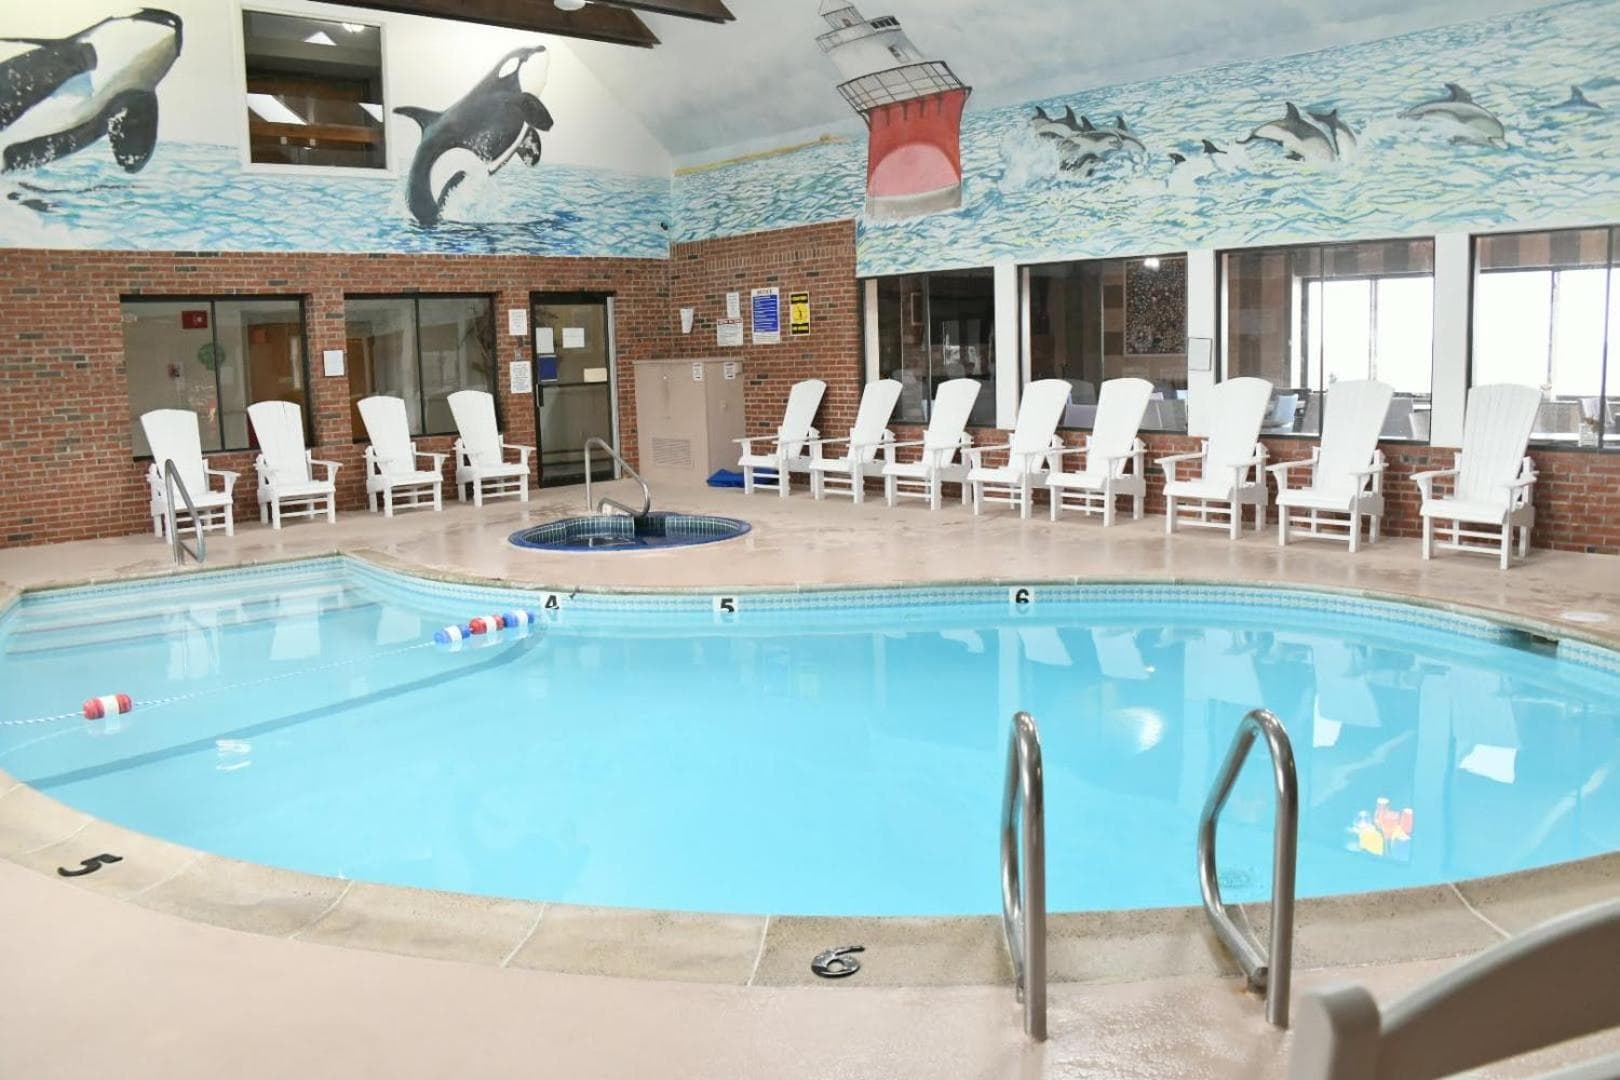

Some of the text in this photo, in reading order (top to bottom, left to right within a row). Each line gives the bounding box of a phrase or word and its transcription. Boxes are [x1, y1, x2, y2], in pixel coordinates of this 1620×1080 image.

[545, 595, 560, 610] 4
[1016, 588, 1029, 604] 6
[720, 597, 735, 613] 5
[57, 853, 123, 877] 5
[811, 945, 866, 979] 6
